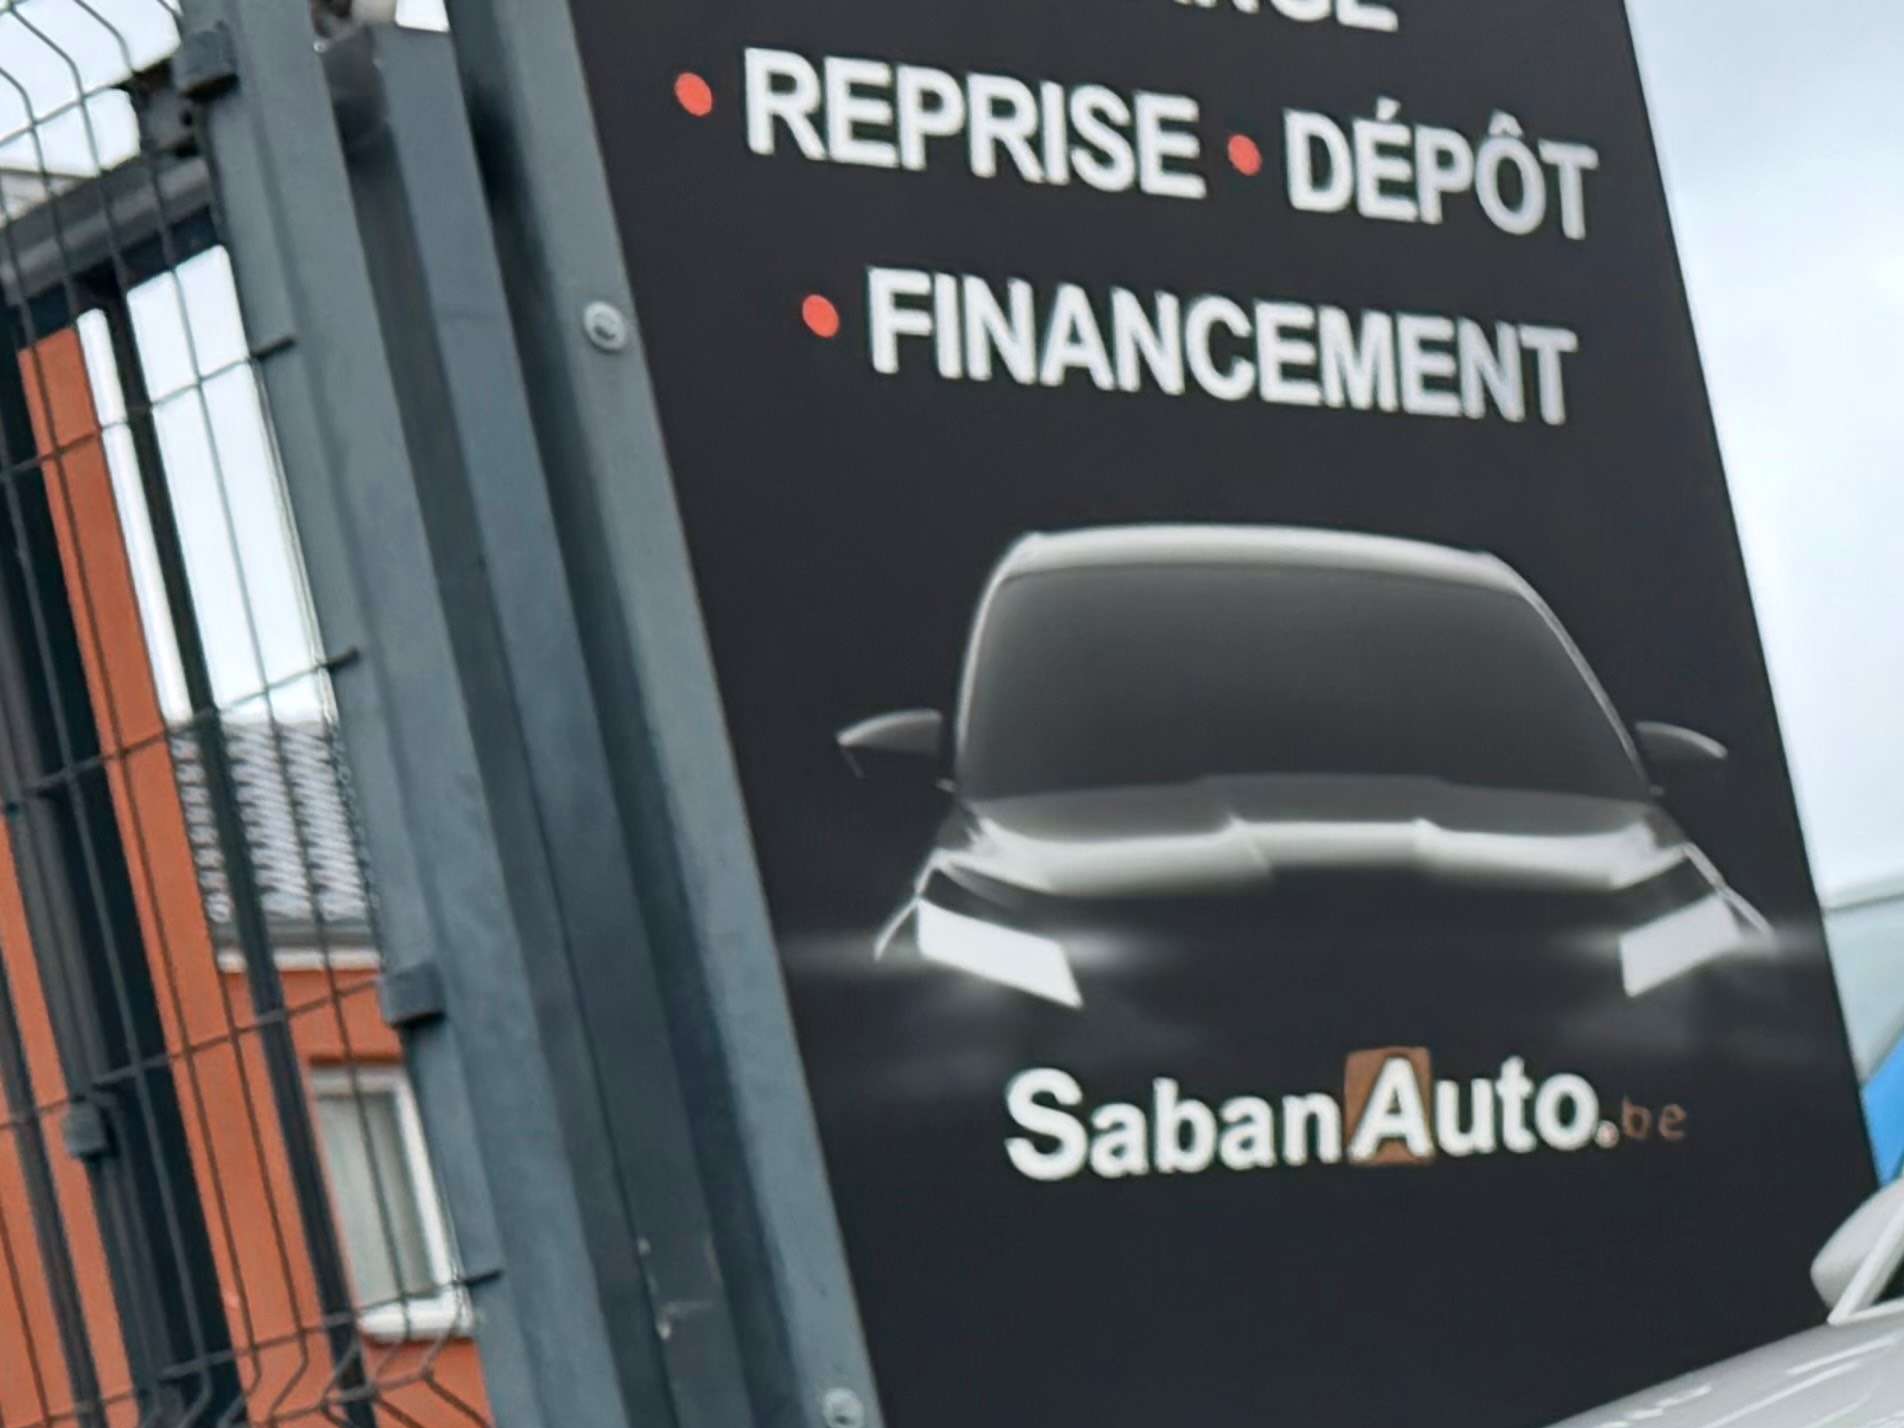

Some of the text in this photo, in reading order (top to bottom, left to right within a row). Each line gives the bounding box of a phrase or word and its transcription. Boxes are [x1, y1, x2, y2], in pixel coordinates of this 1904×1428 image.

[743, 46, 1600, 240] REPRISE DÉPÔT
[866, 264, 1579, 426] FINANCEMENT
